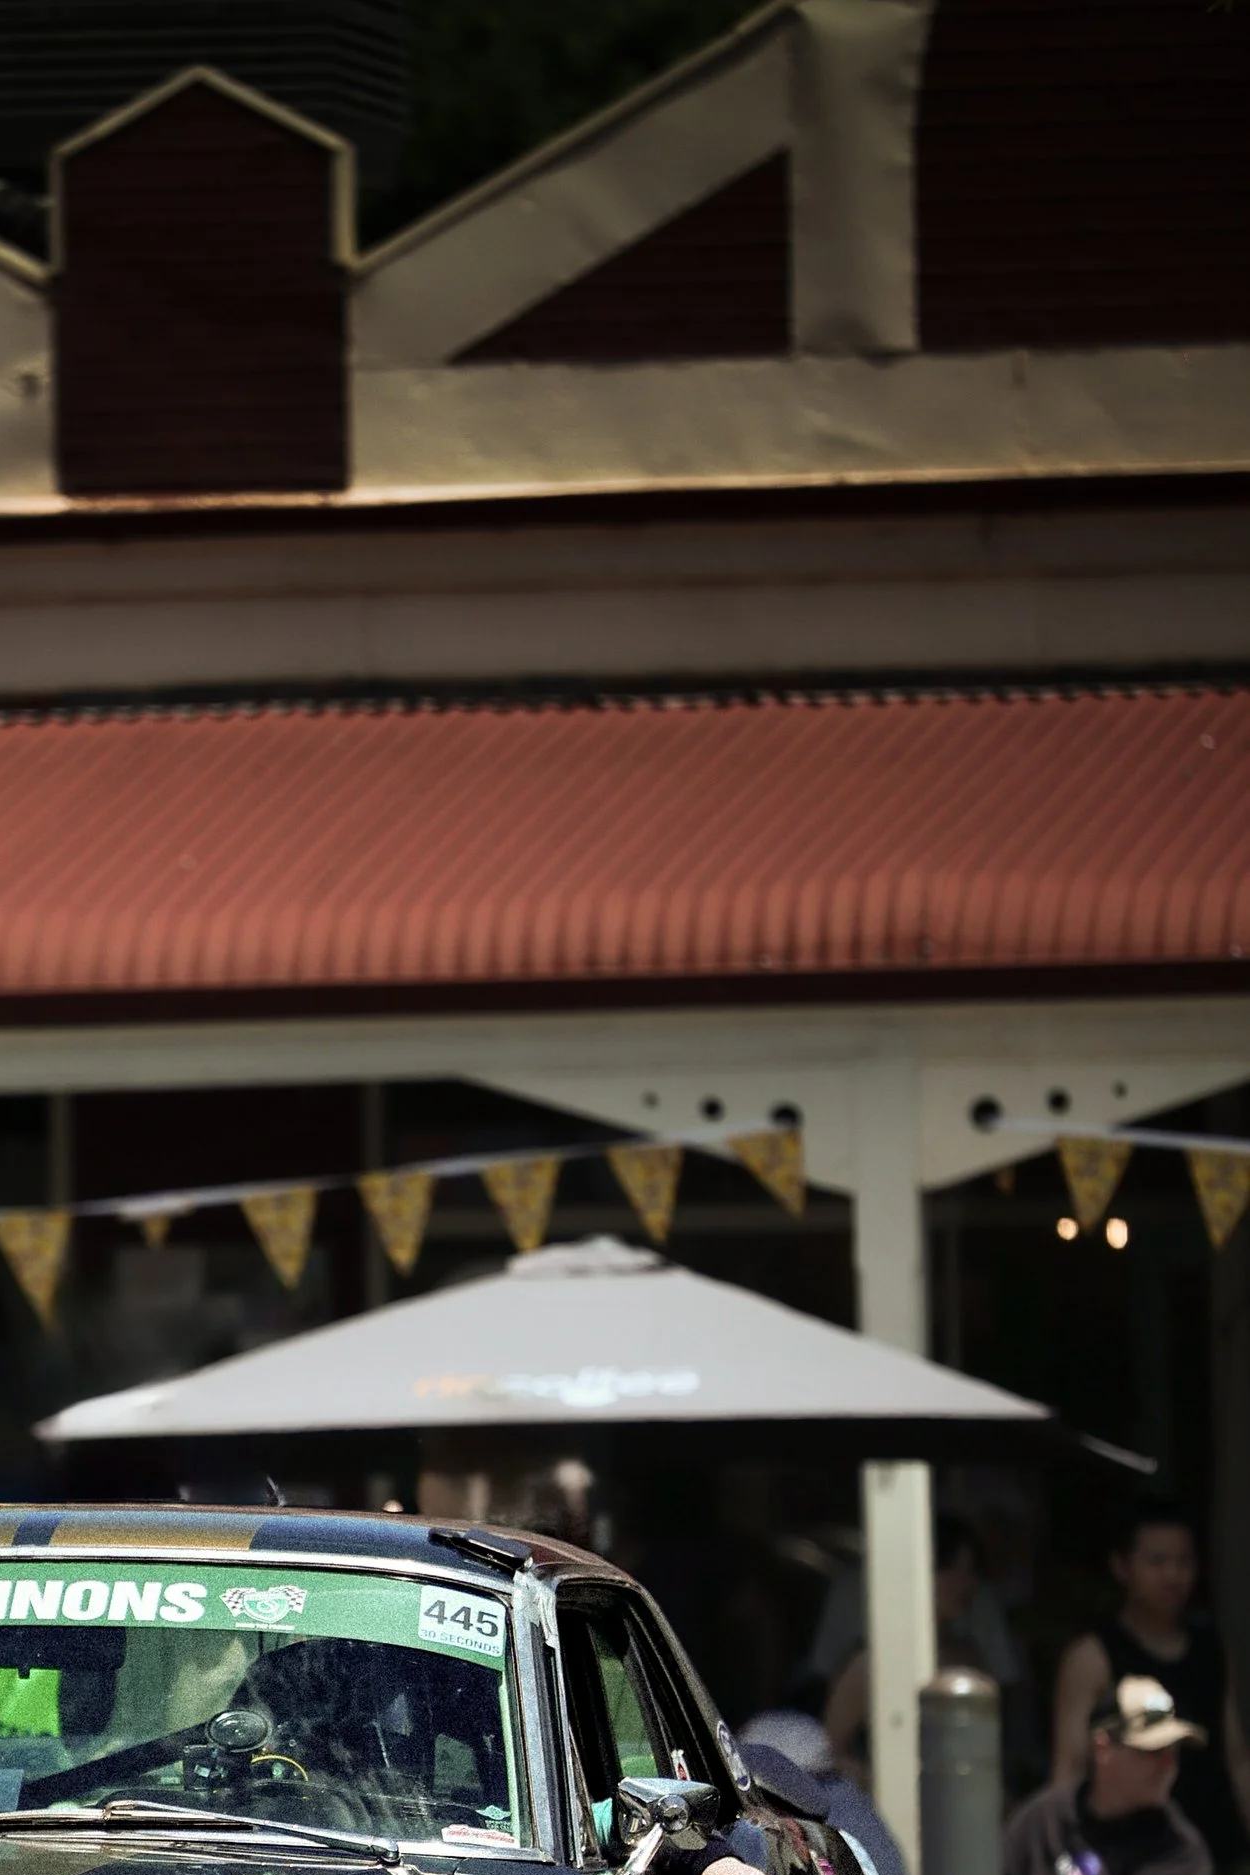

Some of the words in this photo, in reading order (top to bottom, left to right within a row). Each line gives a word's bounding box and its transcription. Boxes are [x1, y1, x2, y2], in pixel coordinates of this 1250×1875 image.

[423, 1599, 499, 1638] 445
[420, 1629, 437, 1639] 30
[440, 1631, 500, 1655] SECONDS
